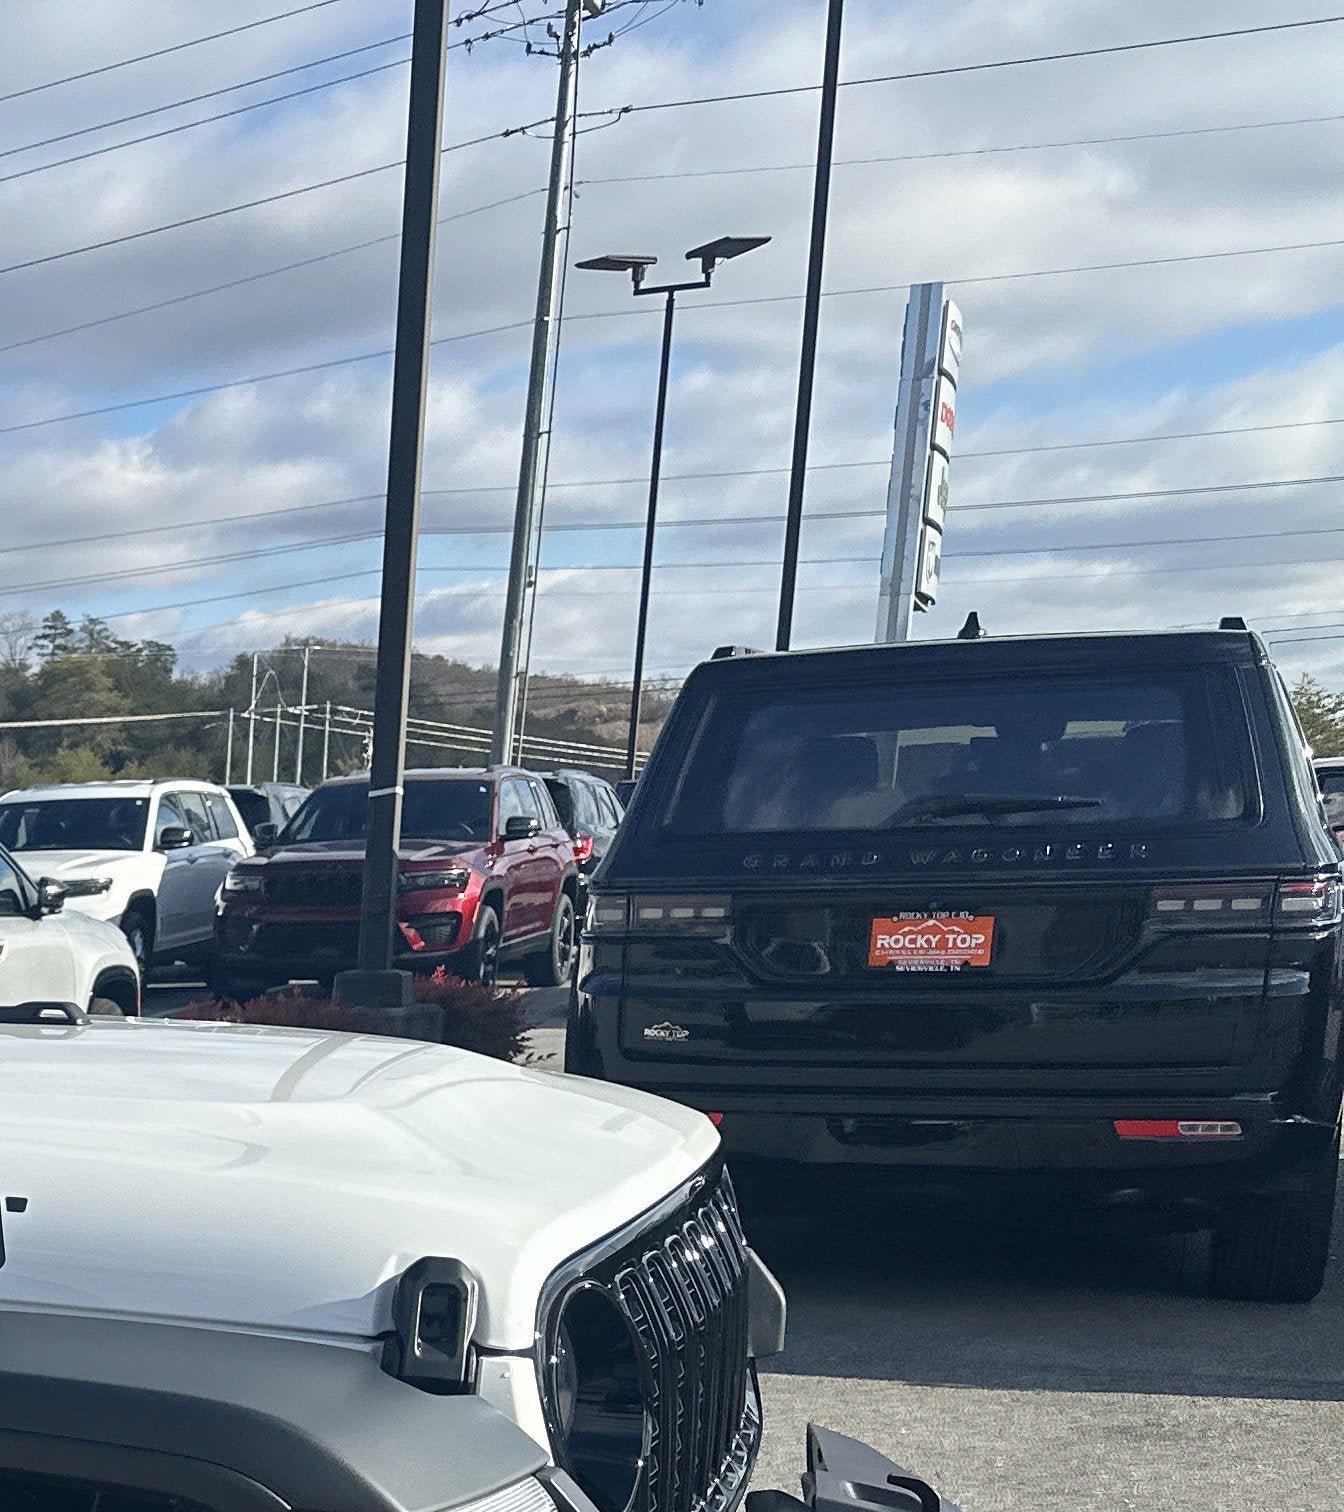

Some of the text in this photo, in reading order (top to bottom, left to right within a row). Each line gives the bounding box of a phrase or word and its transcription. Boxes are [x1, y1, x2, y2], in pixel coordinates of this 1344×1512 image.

[743, 852, 880, 868] GRAND
[876, 933, 985, 948] ROCKY TOP
[643, 1027, 690, 1038] ROCKY TOP
